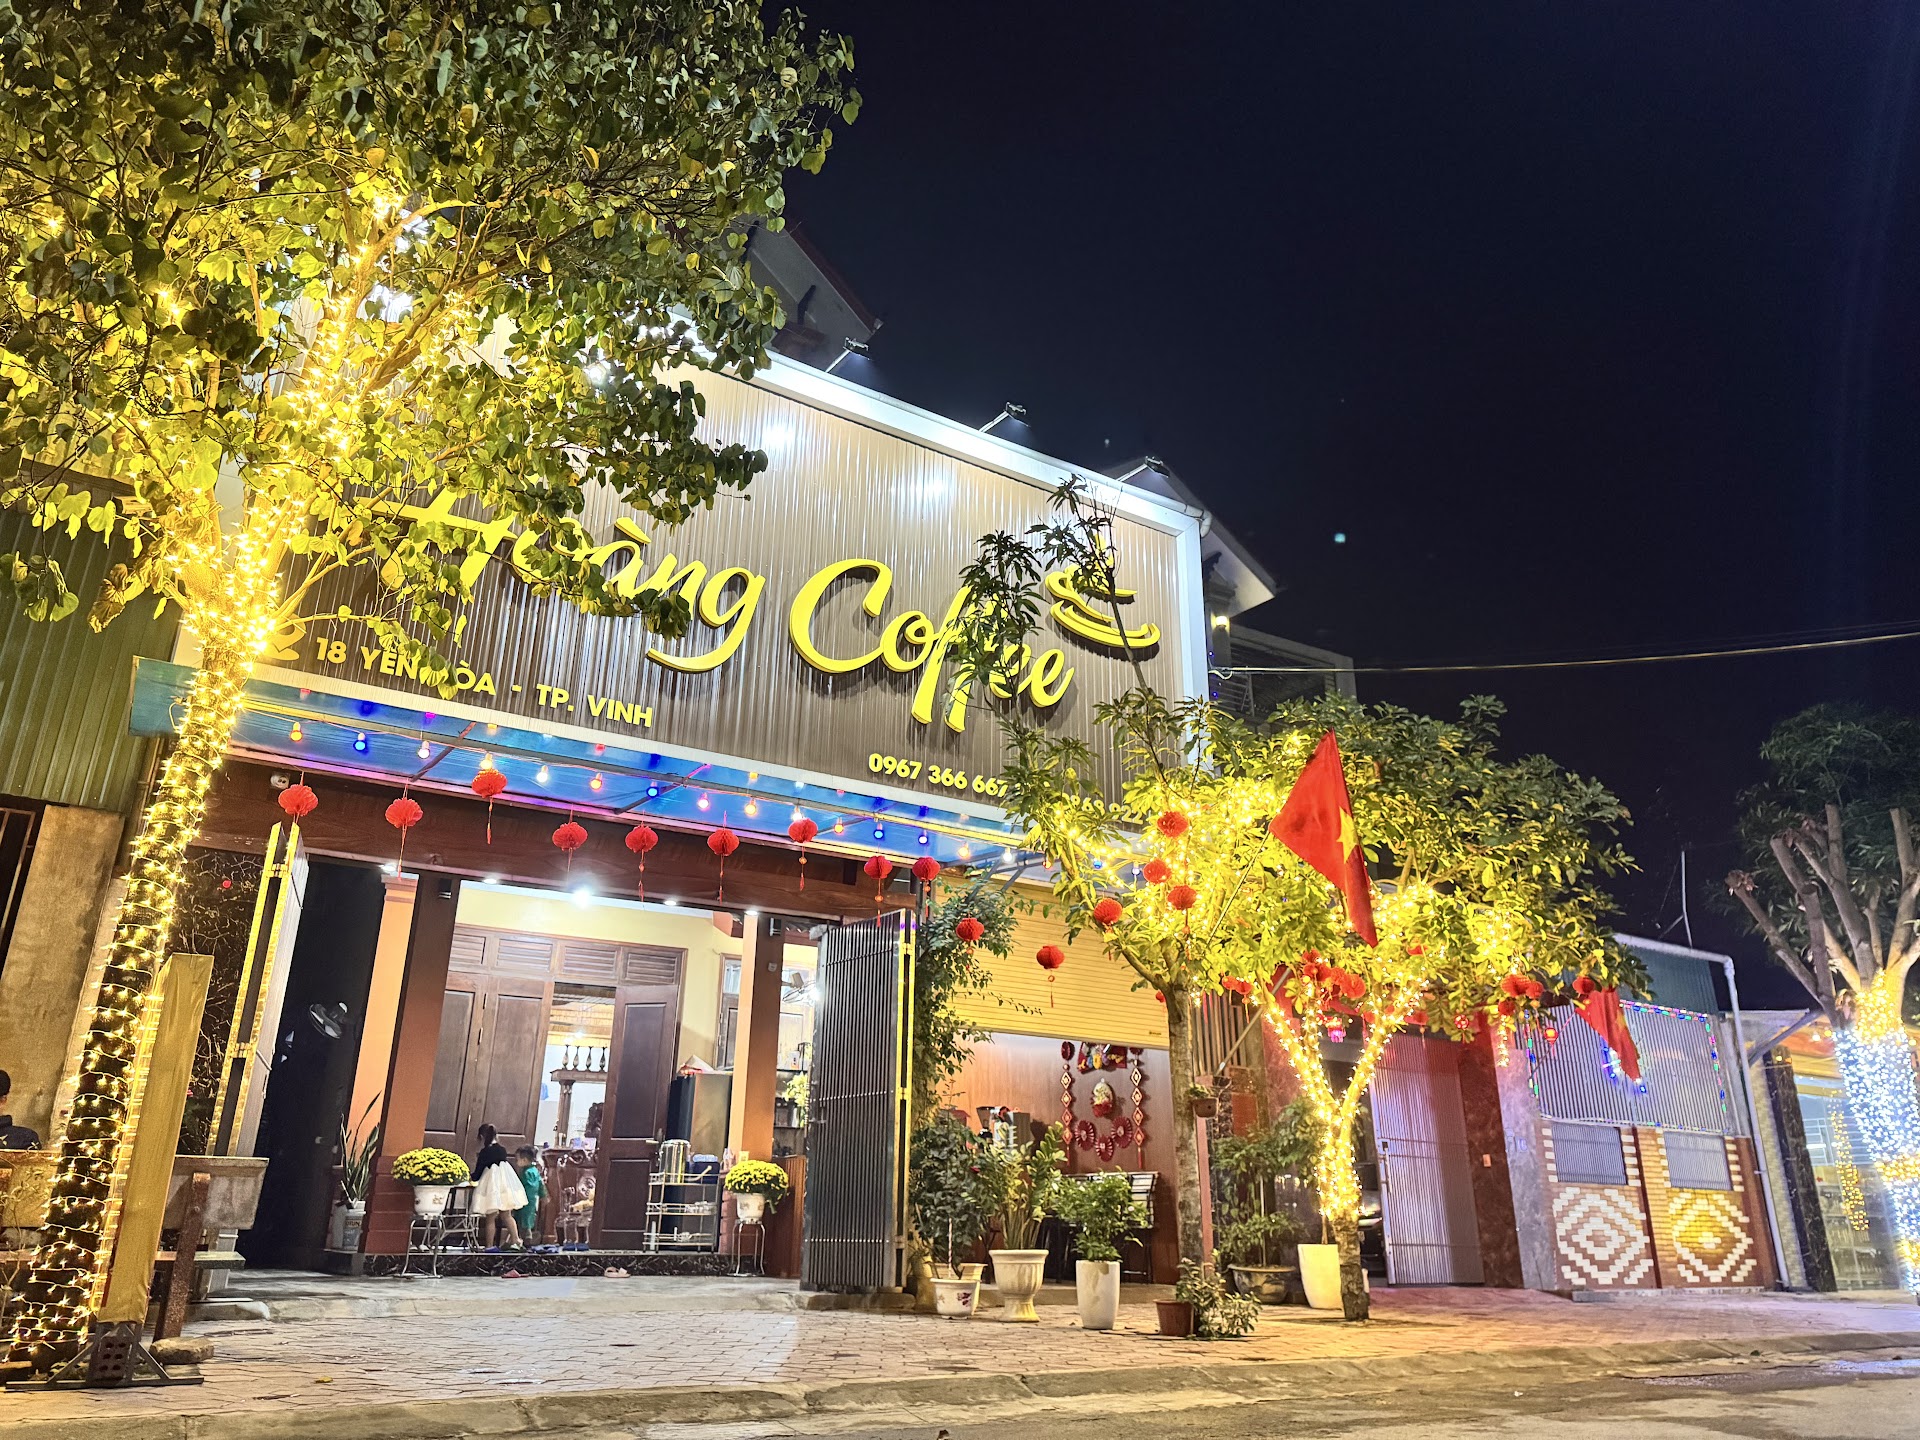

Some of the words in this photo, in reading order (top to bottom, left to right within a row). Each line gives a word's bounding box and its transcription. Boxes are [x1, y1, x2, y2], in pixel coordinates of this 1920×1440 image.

[353, 472, 767, 672] Hoàng
[790, 558, 1075, 732] Coffee
[316, 637, 347, 664] 18
[438, 660, 497, 696] ÒA
[536, 683, 575, 712] TP.
[587, 694, 653, 728] VINH
[868, 753, 922, 780] 0967
[928, 765, 968, 790] 366
[972, 775, 1009, 798] 667
